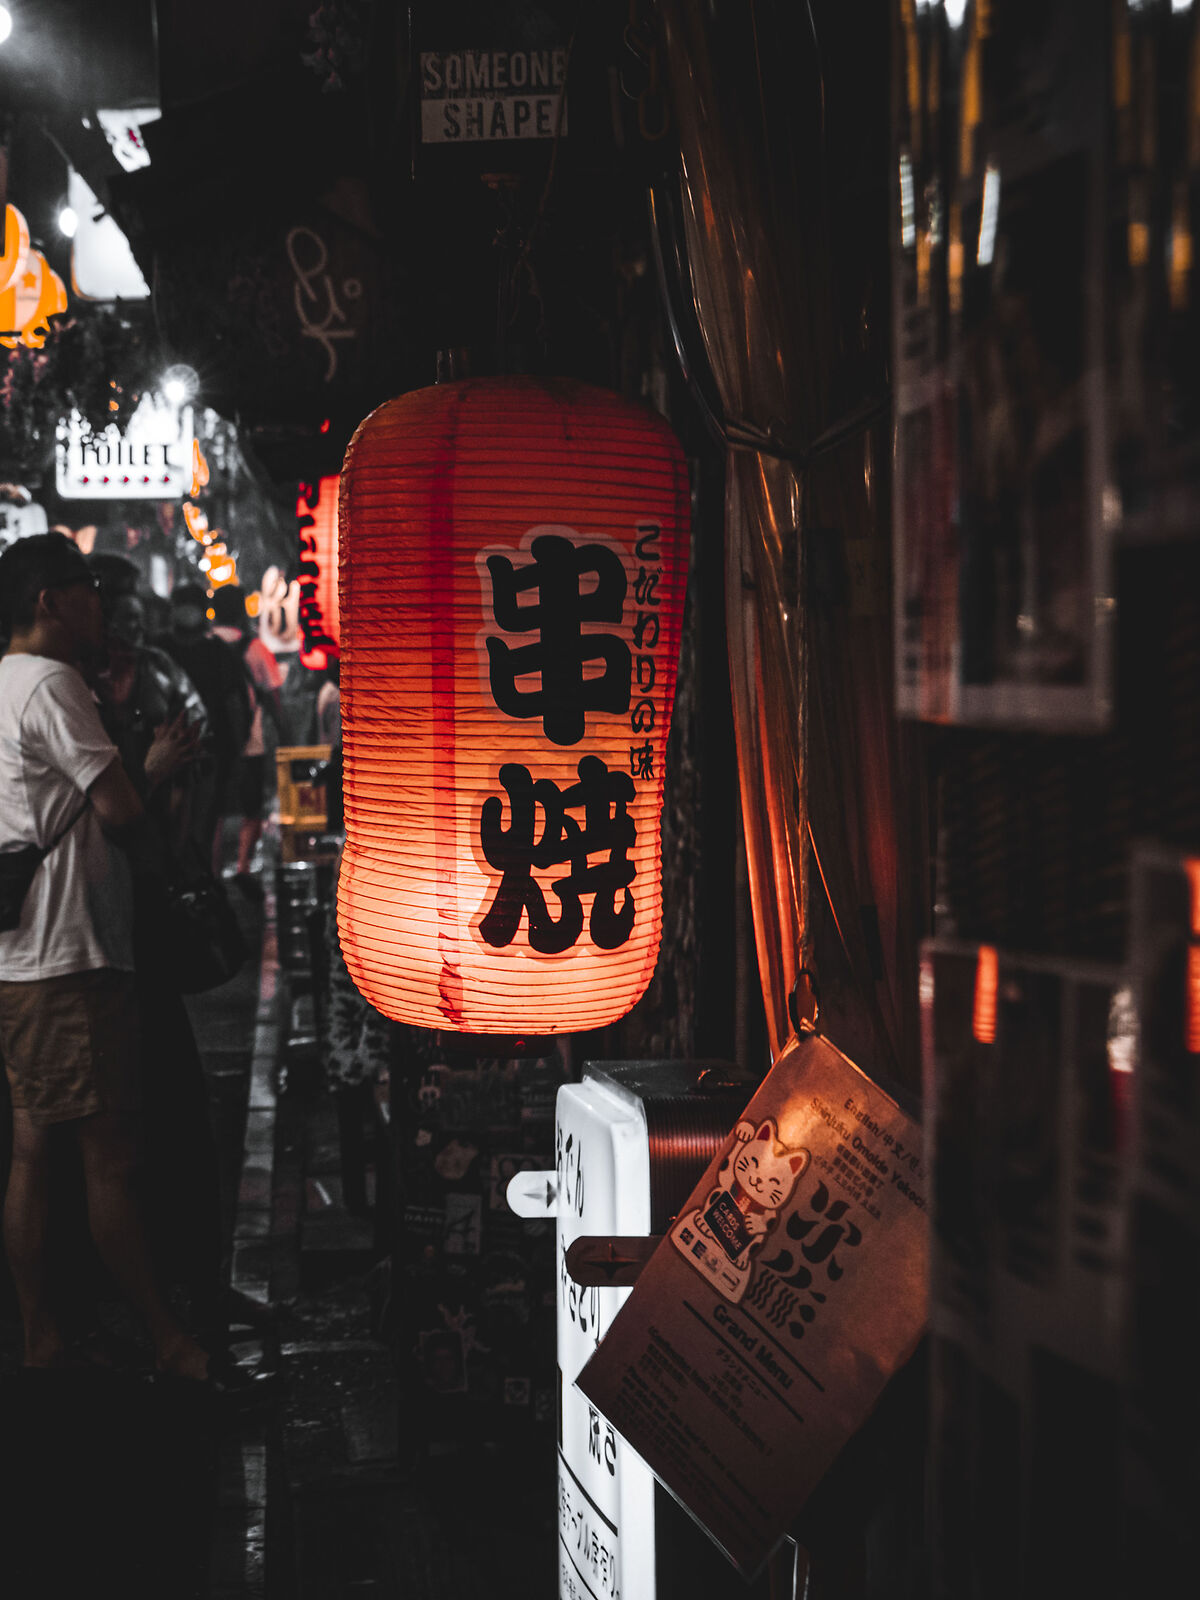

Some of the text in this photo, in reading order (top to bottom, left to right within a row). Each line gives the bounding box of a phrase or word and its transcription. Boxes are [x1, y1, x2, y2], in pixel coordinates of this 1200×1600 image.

[424, 51, 566, 91] SOMEONE
[443, 99, 553, 138] SHAPE
[81, 443, 170, 465] TOILET
[629, 524, 663, 782] こだわりの味
[478, 535, 637, 955] 串焼
[711, 1207, 744, 1251] WELCOME
[717, 1200, 742, 1232] CARDS
[711, 1301, 760, 1353] Grand
[754, 1344, 795, 1390] Menu
